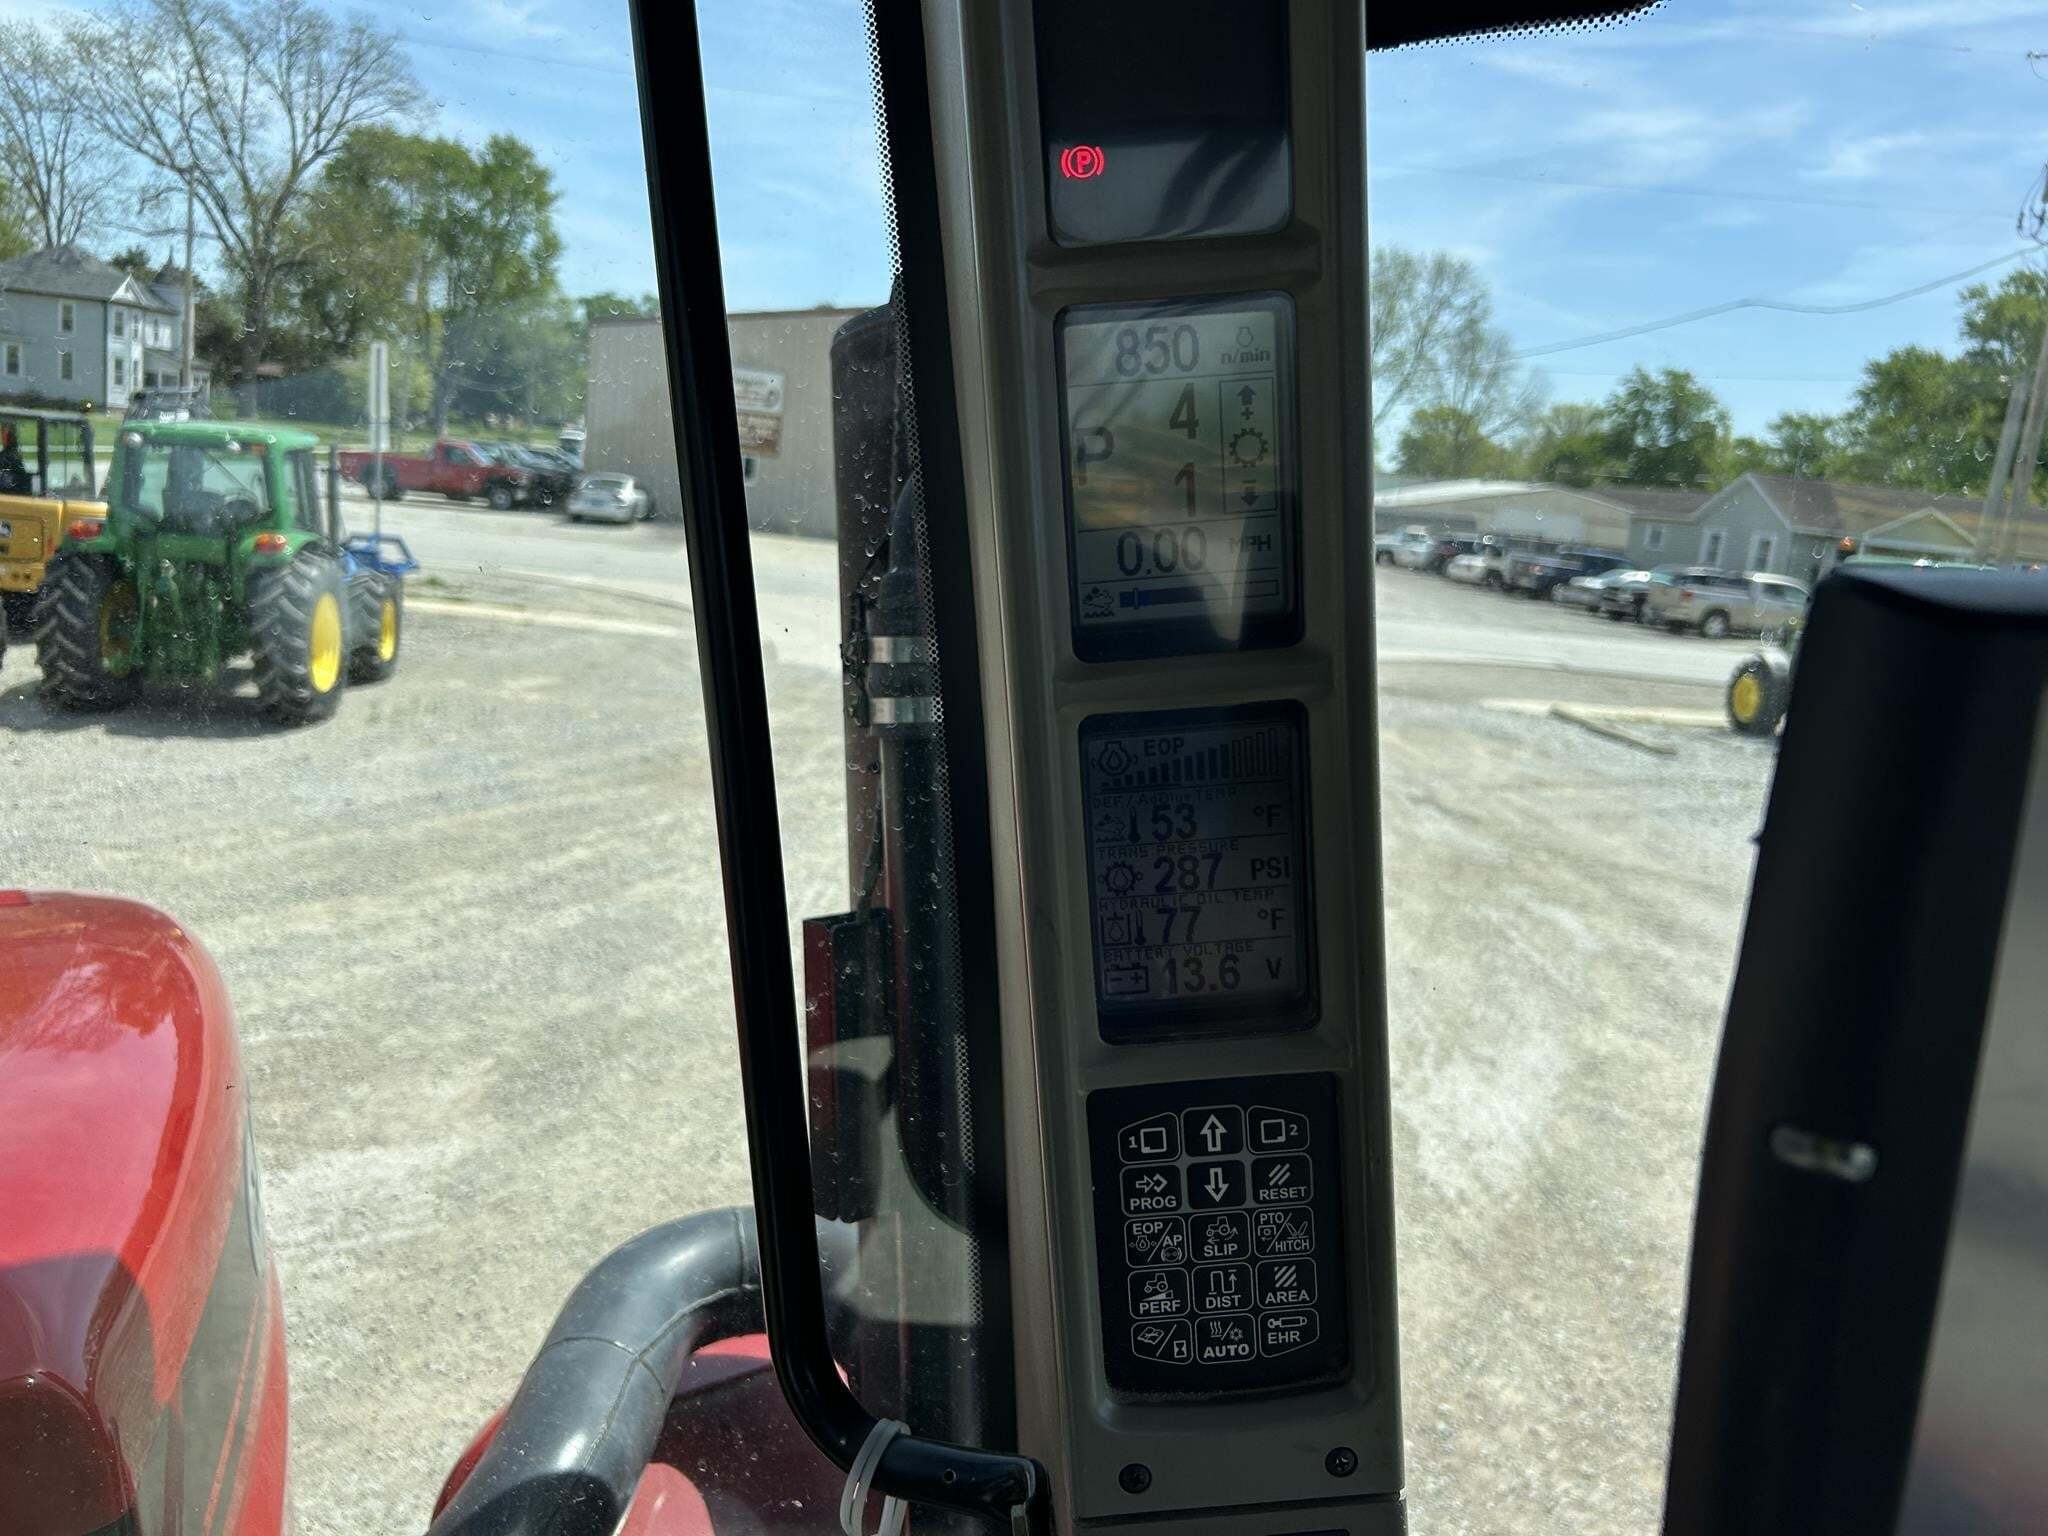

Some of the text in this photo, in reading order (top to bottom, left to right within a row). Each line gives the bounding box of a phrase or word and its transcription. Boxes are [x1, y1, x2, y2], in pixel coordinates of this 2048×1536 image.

[1115, 324, 1272, 377] 850 n/min
[1168, 382, 1200, 440] 4
[1074, 425, 1115, 486] P
[1174, 462, 1197, 518] 1
[1116, 526, 1207, 577] 0.00
[1144, 736, 1185, 757] EOP
[1152, 803, 1283, 841] 53 °F
[1098, 838, 1240, 861] TRANS PRESSURE
[1153, 852, 1290, 892] 287 PSI
[1197, 891, 1224, 906] OIL
[1234, 888, 1275, 902] TEMP
[1157, 906, 1286, 943] 77 °F
[1103, 941, 1256, 963] BATTERY VOLTAGE
[1162, 954, 1282, 994] 13.6 V
[1289, 1124, 1300, 1137] 2
[1128, 1136, 1139, 1149] 1
[1259, 1186, 1308, 1201] RESET
[1130, 1196, 1178, 1211] PROG
[1260, 1212, 1286, 1225] PTO
[1133, 1222, 1164, 1236] EOP
[1162, 1234, 1184, 1248] AP
[1275, 1239, 1310, 1252] HITCH
[1204, 1243, 1239, 1257] SLIP
[1206, 1295, 1242, 1309] DIST
[1265, 1289, 1310, 1304] AREA
[1139, 1300, 1181, 1314] PERF
[1267, 1331, 1301, 1345] EHR
[1204, 1343, 1250, 1359] AUTO
